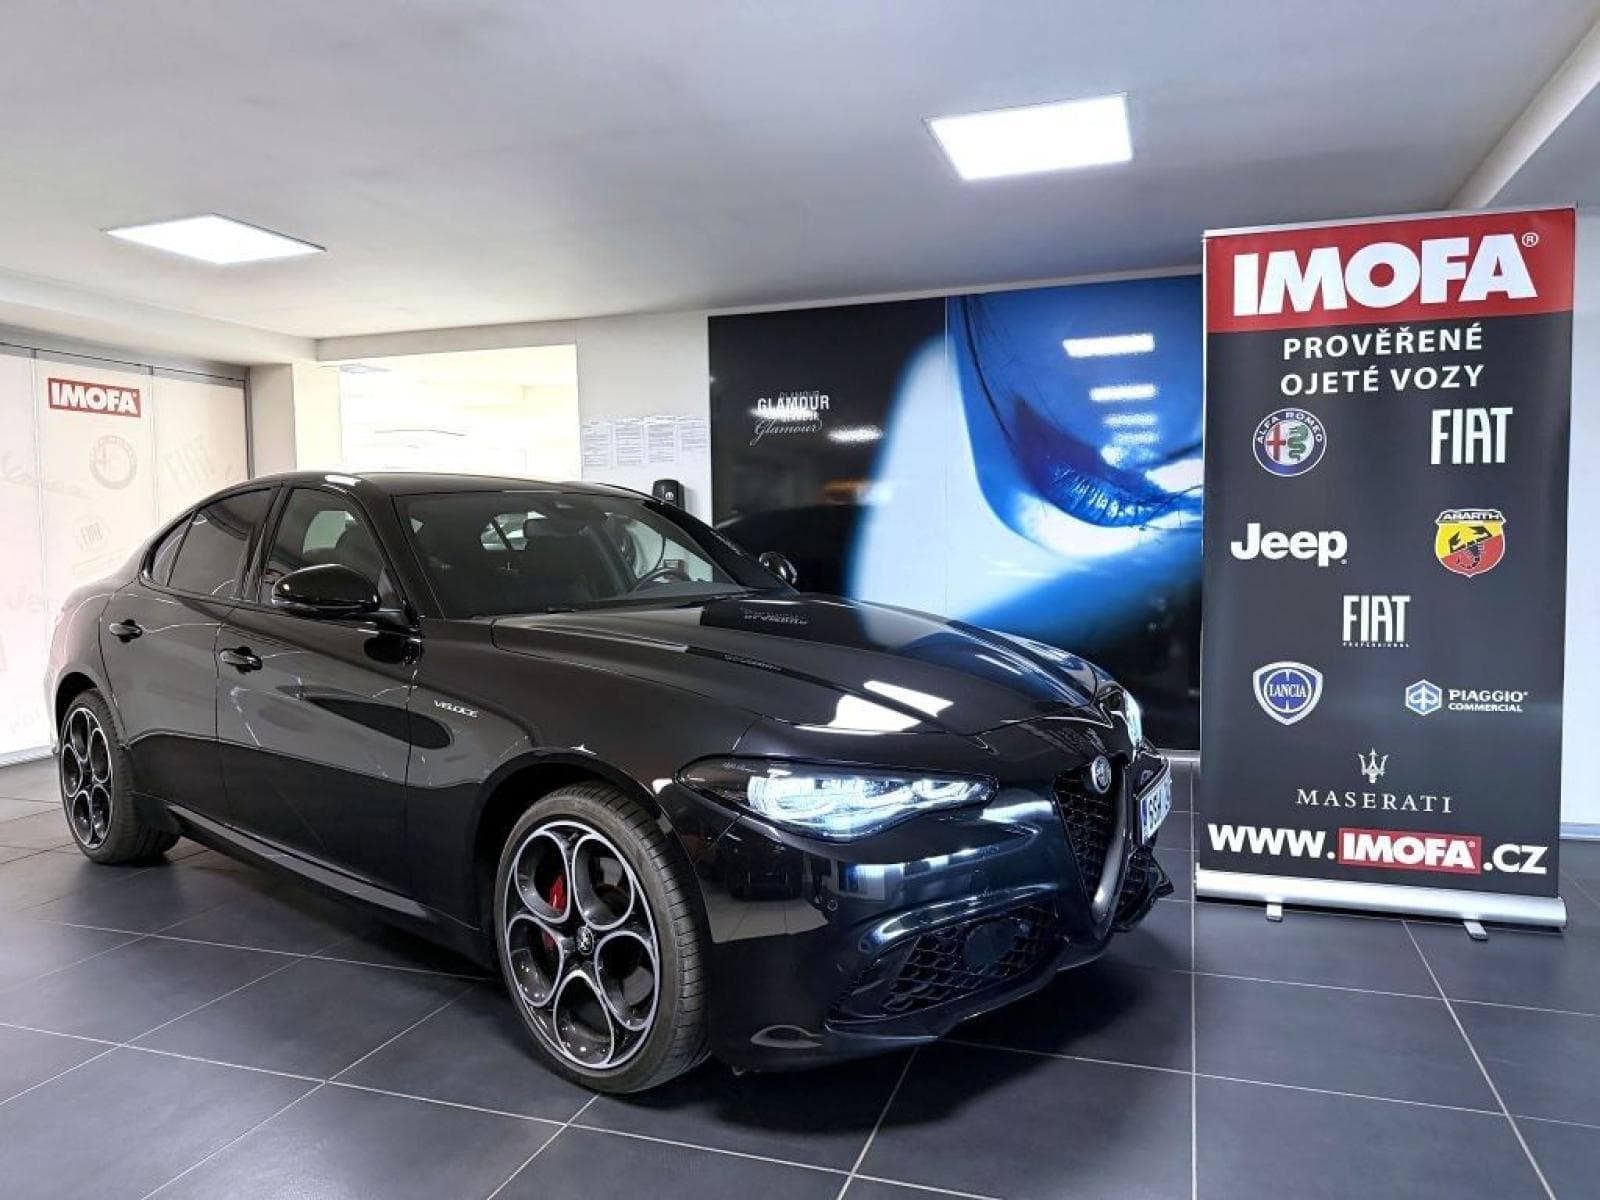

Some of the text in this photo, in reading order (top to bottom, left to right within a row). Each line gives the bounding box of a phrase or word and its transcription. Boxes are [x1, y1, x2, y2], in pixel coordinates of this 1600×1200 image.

[1283, 323, 1483, 360] PROVĚŘENÉ
[1280, 364, 1485, 396] OJETÉ VOZY
[51, 383, 139, 415] IMOFA
[757, 394, 830, 413] GLAMOUR
[1256, 411, 1323, 445] ALFA ROMEO
[1430, 407, 1513, 465] FIAT
[1442, 511, 1500, 520] ABARTH
[1230, 522, 1348, 567] Jeep
[1342, 594, 1411, 643] FIAT
[1268, 683, 1307, 699] LANCIA
[1448, 689, 1523, 703] PIAGGIO
[433, 699, 479, 718] VELOCE
[1447, 702, 1523, 713] COMMERCIAL
[1295, 788, 1453, 814] MASERATI
